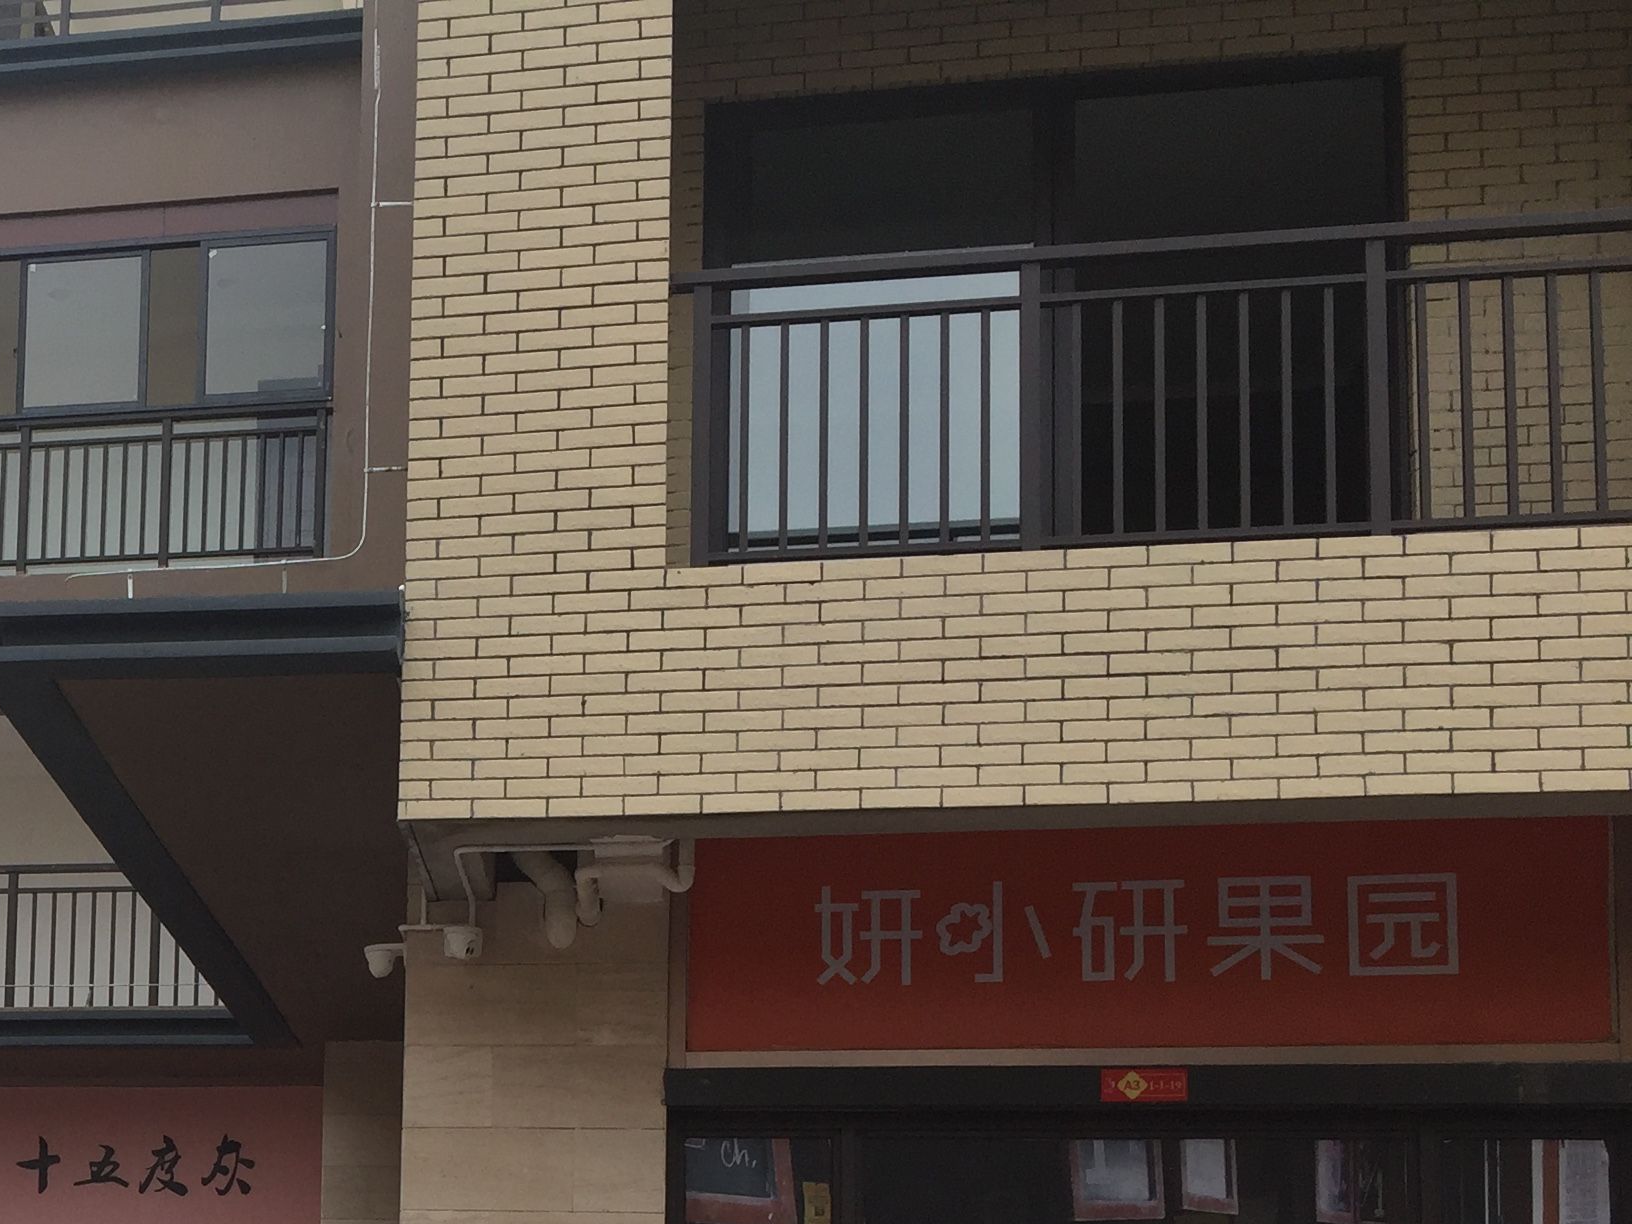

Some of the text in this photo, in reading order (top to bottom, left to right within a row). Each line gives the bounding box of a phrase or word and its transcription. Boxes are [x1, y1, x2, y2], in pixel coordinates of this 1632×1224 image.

[813, 871, 1461, 986] 妍小研果园
[1123, 1080, 1141, 1091] A3
[15, 1133, 256, 1197] 十五度灰
